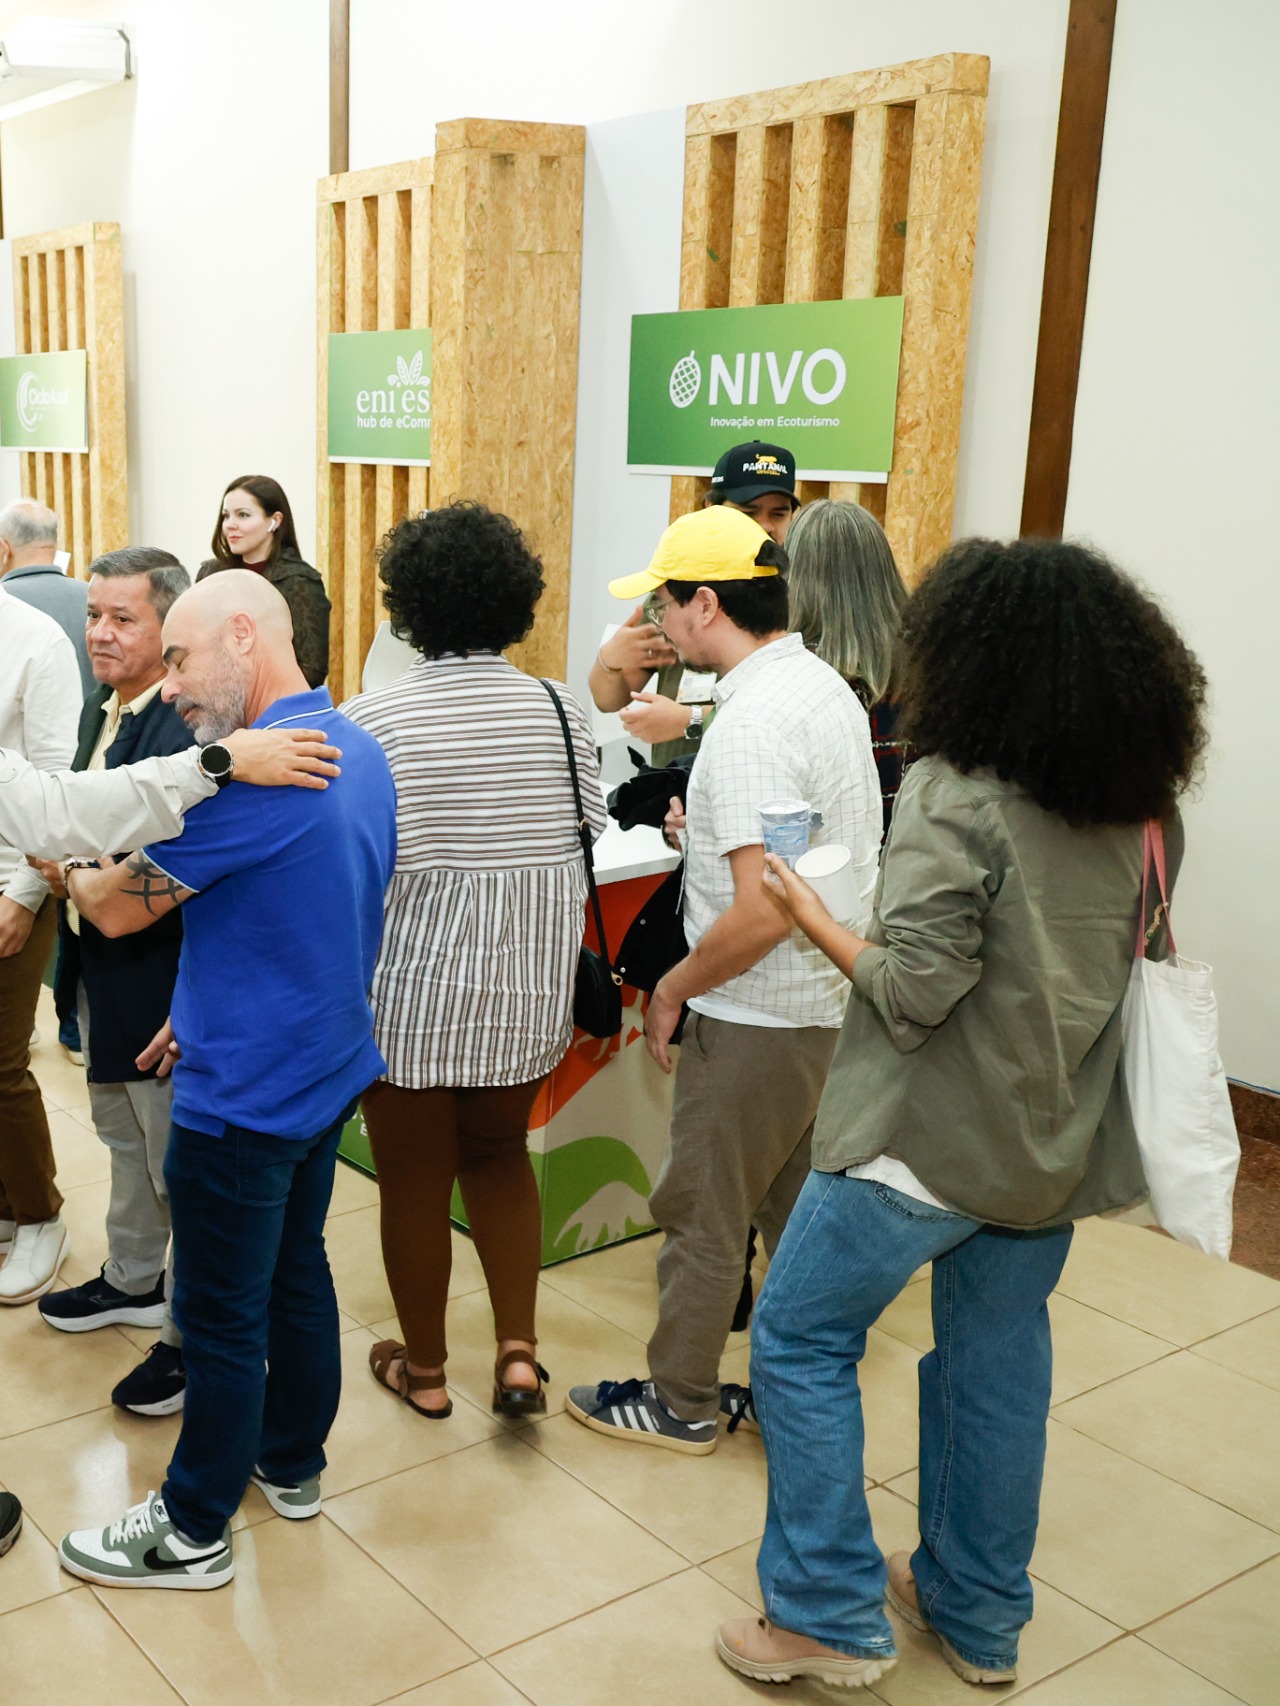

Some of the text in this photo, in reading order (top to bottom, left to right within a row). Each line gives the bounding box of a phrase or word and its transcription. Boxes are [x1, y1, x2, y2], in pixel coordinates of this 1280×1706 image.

[708, 348, 847, 405] NIVO
[357, 415, 377, 428] hub
[380, 415, 392, 428] de
[710, 416, 840, 429] Inovação em Ecoturismo
